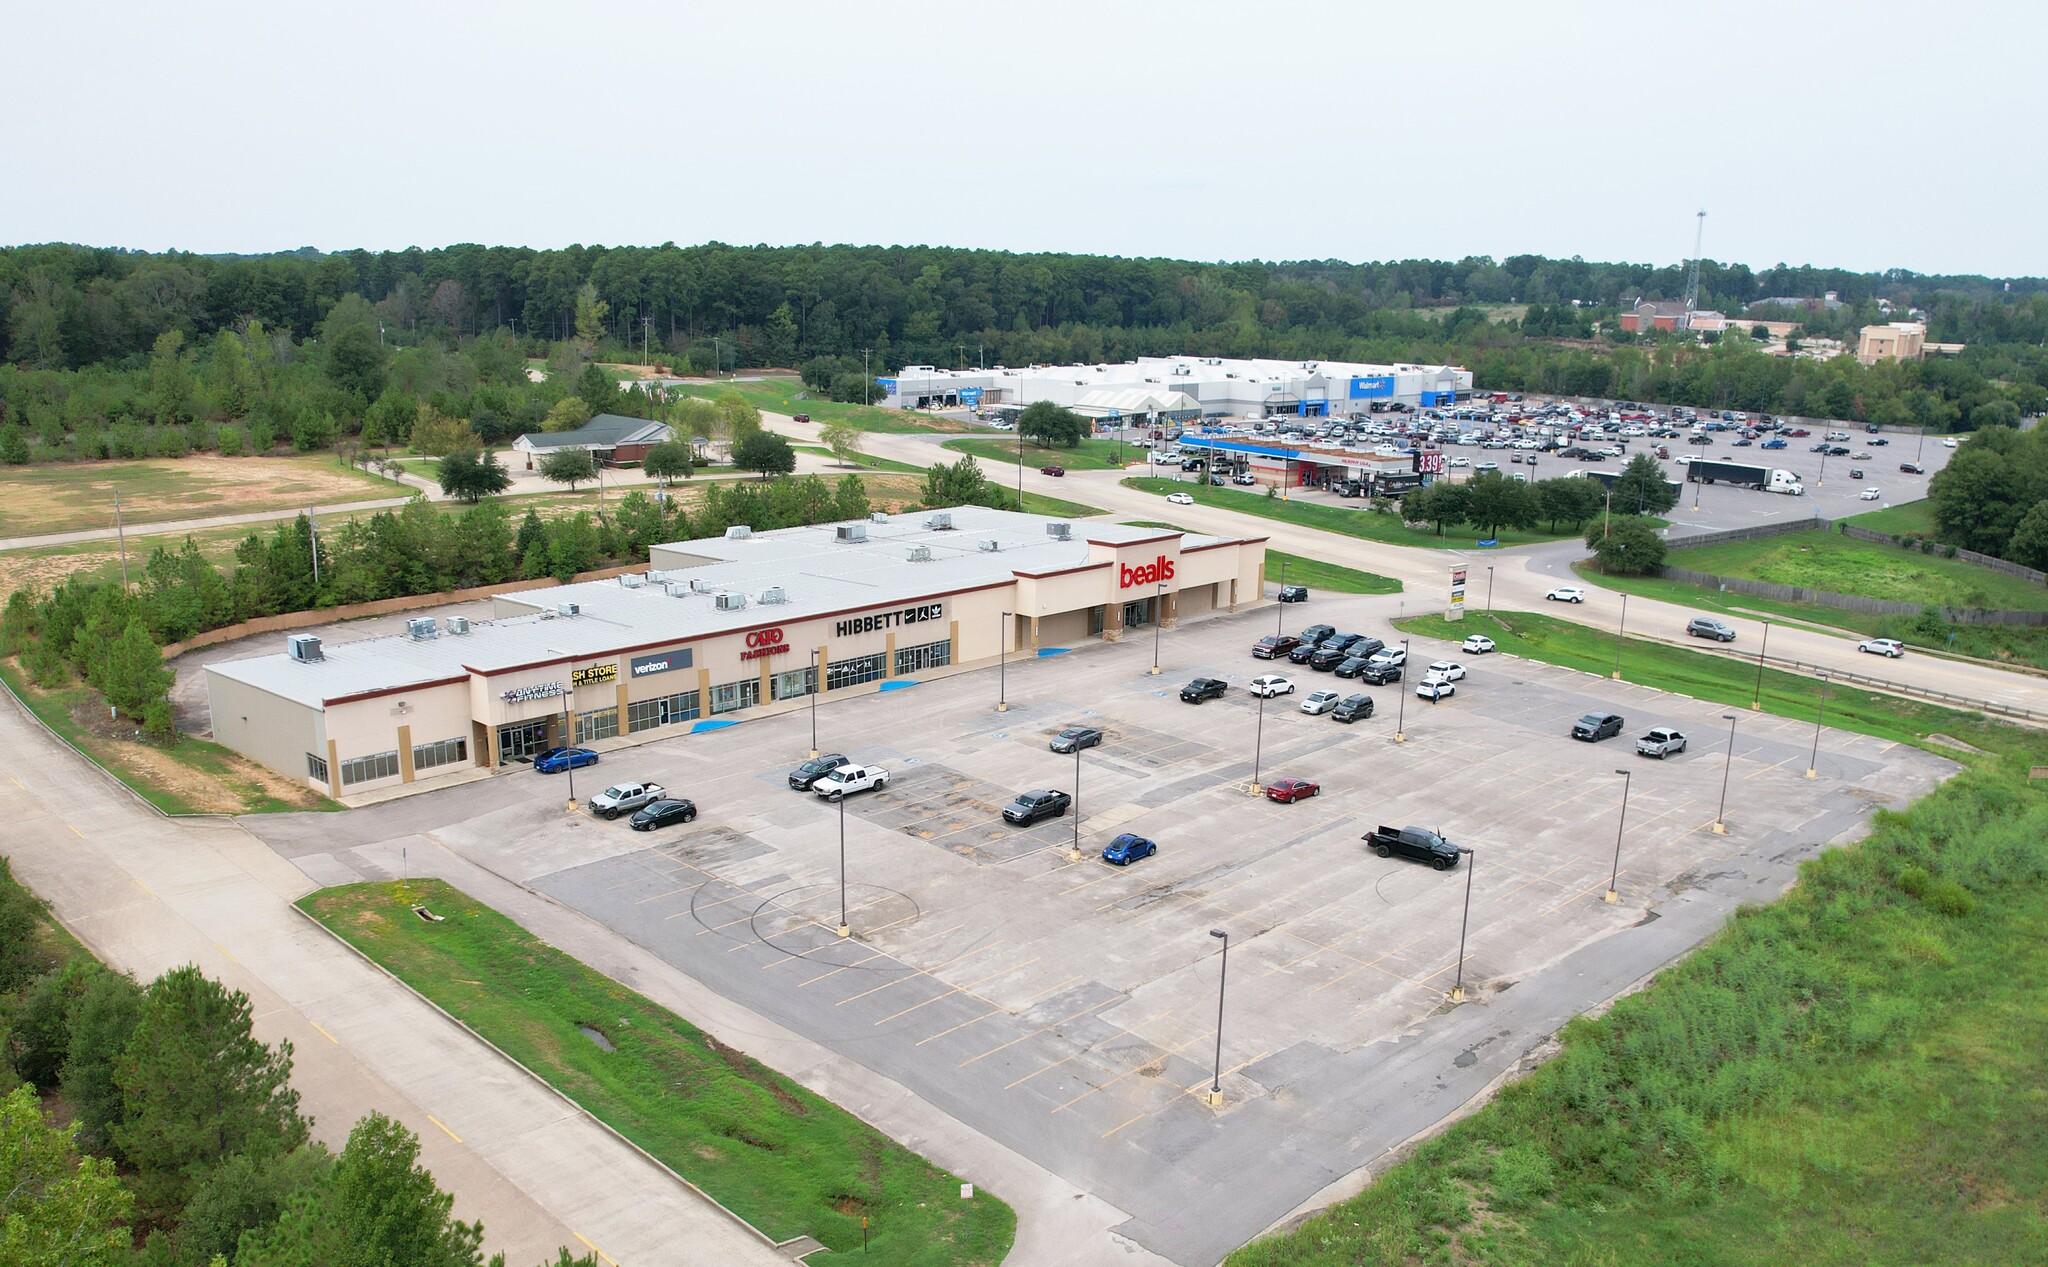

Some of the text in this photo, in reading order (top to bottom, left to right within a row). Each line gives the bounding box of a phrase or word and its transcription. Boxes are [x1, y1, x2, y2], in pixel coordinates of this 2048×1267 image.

[1359, 381, 1379, 390] Walmart
[1120, 555, 1175, 589] bealls
[836, 611, 903, 637] HIBBETT
[745, 628, 784, 648] CATO
[740, 644, 790, 661] FASHIONS
[588, 664, 618, 678] STORE
[634, 661, 668, 674] verizon
[584, 677, 599, 685] TITLE
[515, 681, 564, 697] ANYTIME
[516, 689, 565, 703] FITNESS
